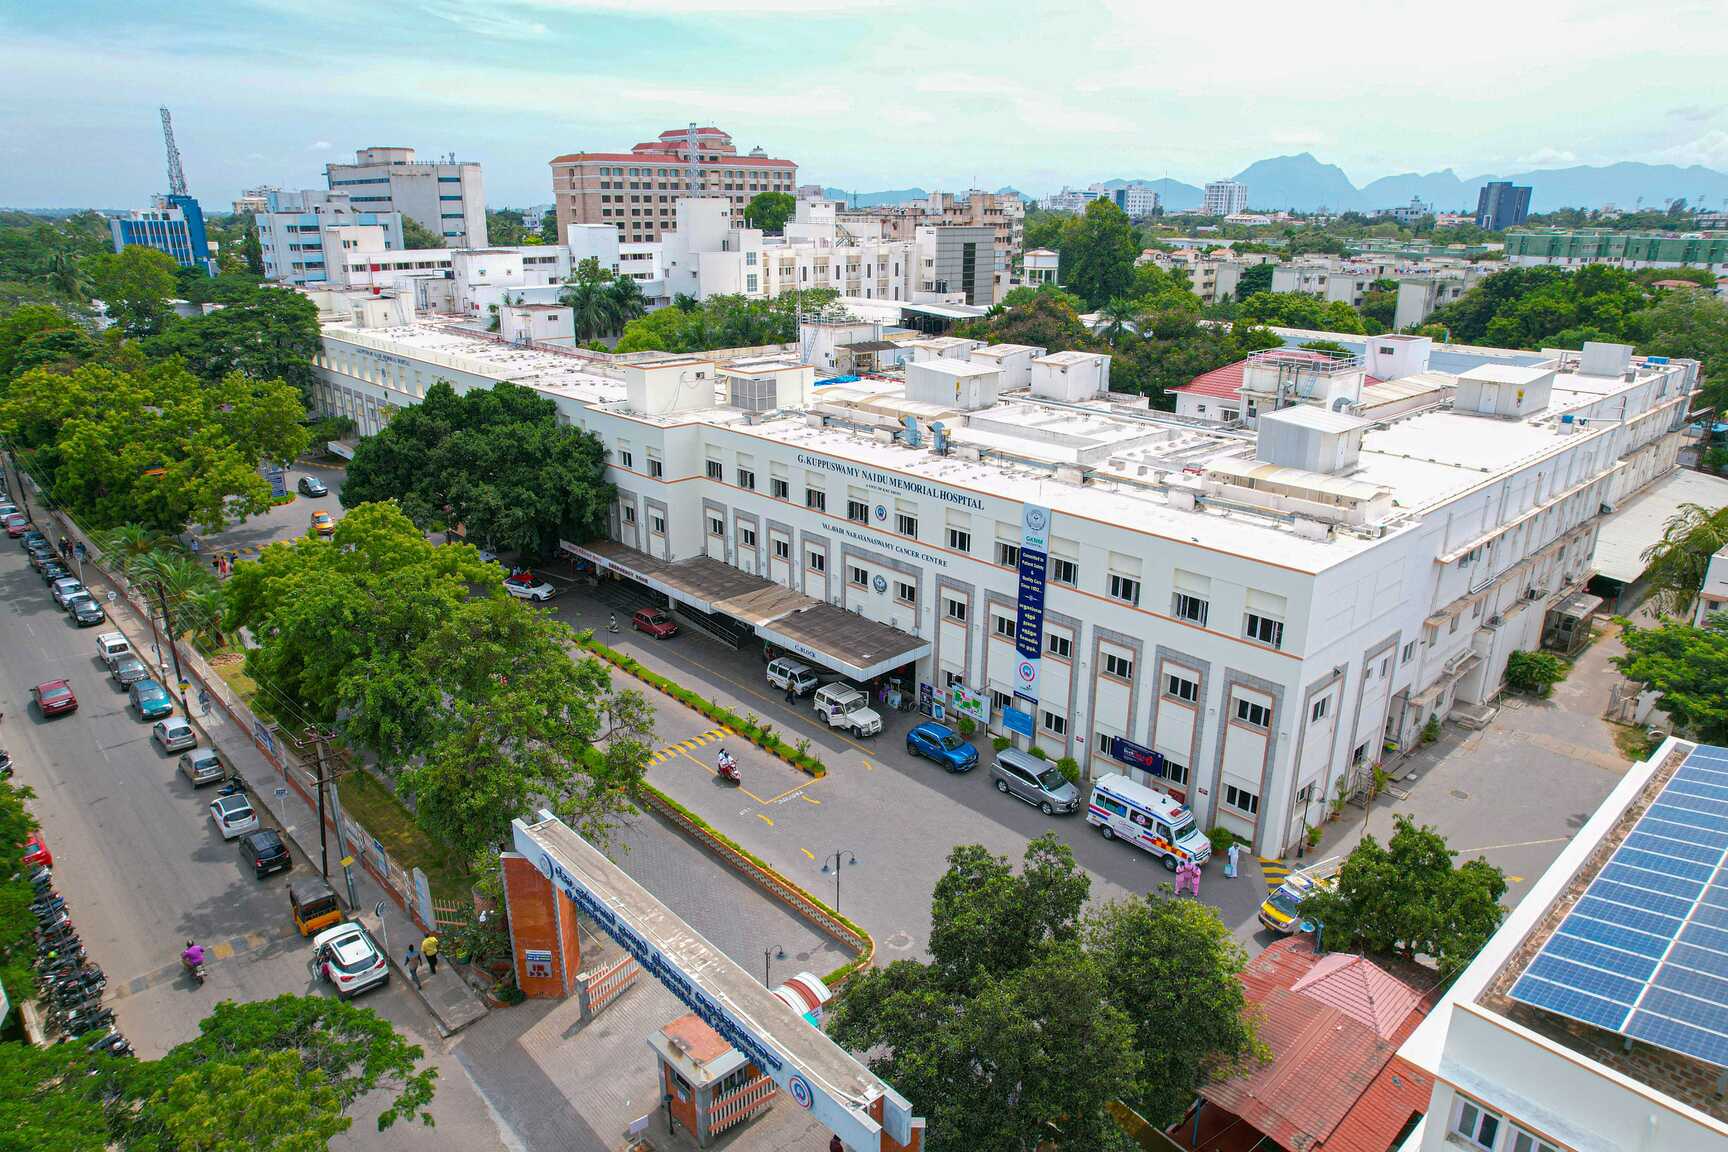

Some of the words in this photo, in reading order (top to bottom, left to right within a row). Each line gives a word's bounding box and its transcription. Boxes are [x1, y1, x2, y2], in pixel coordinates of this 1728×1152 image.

[797, 454, 860, 477] G.KUPPUSWAMY
[861, 470, 888, 485] NAIDU
[889, 477, 939, 499] MEMORIAL
[939, 489, 985, 510] HOSPITAL
[895, 545, 920, 559] CANCER
[921, 554, 949, 568] CENTRE
